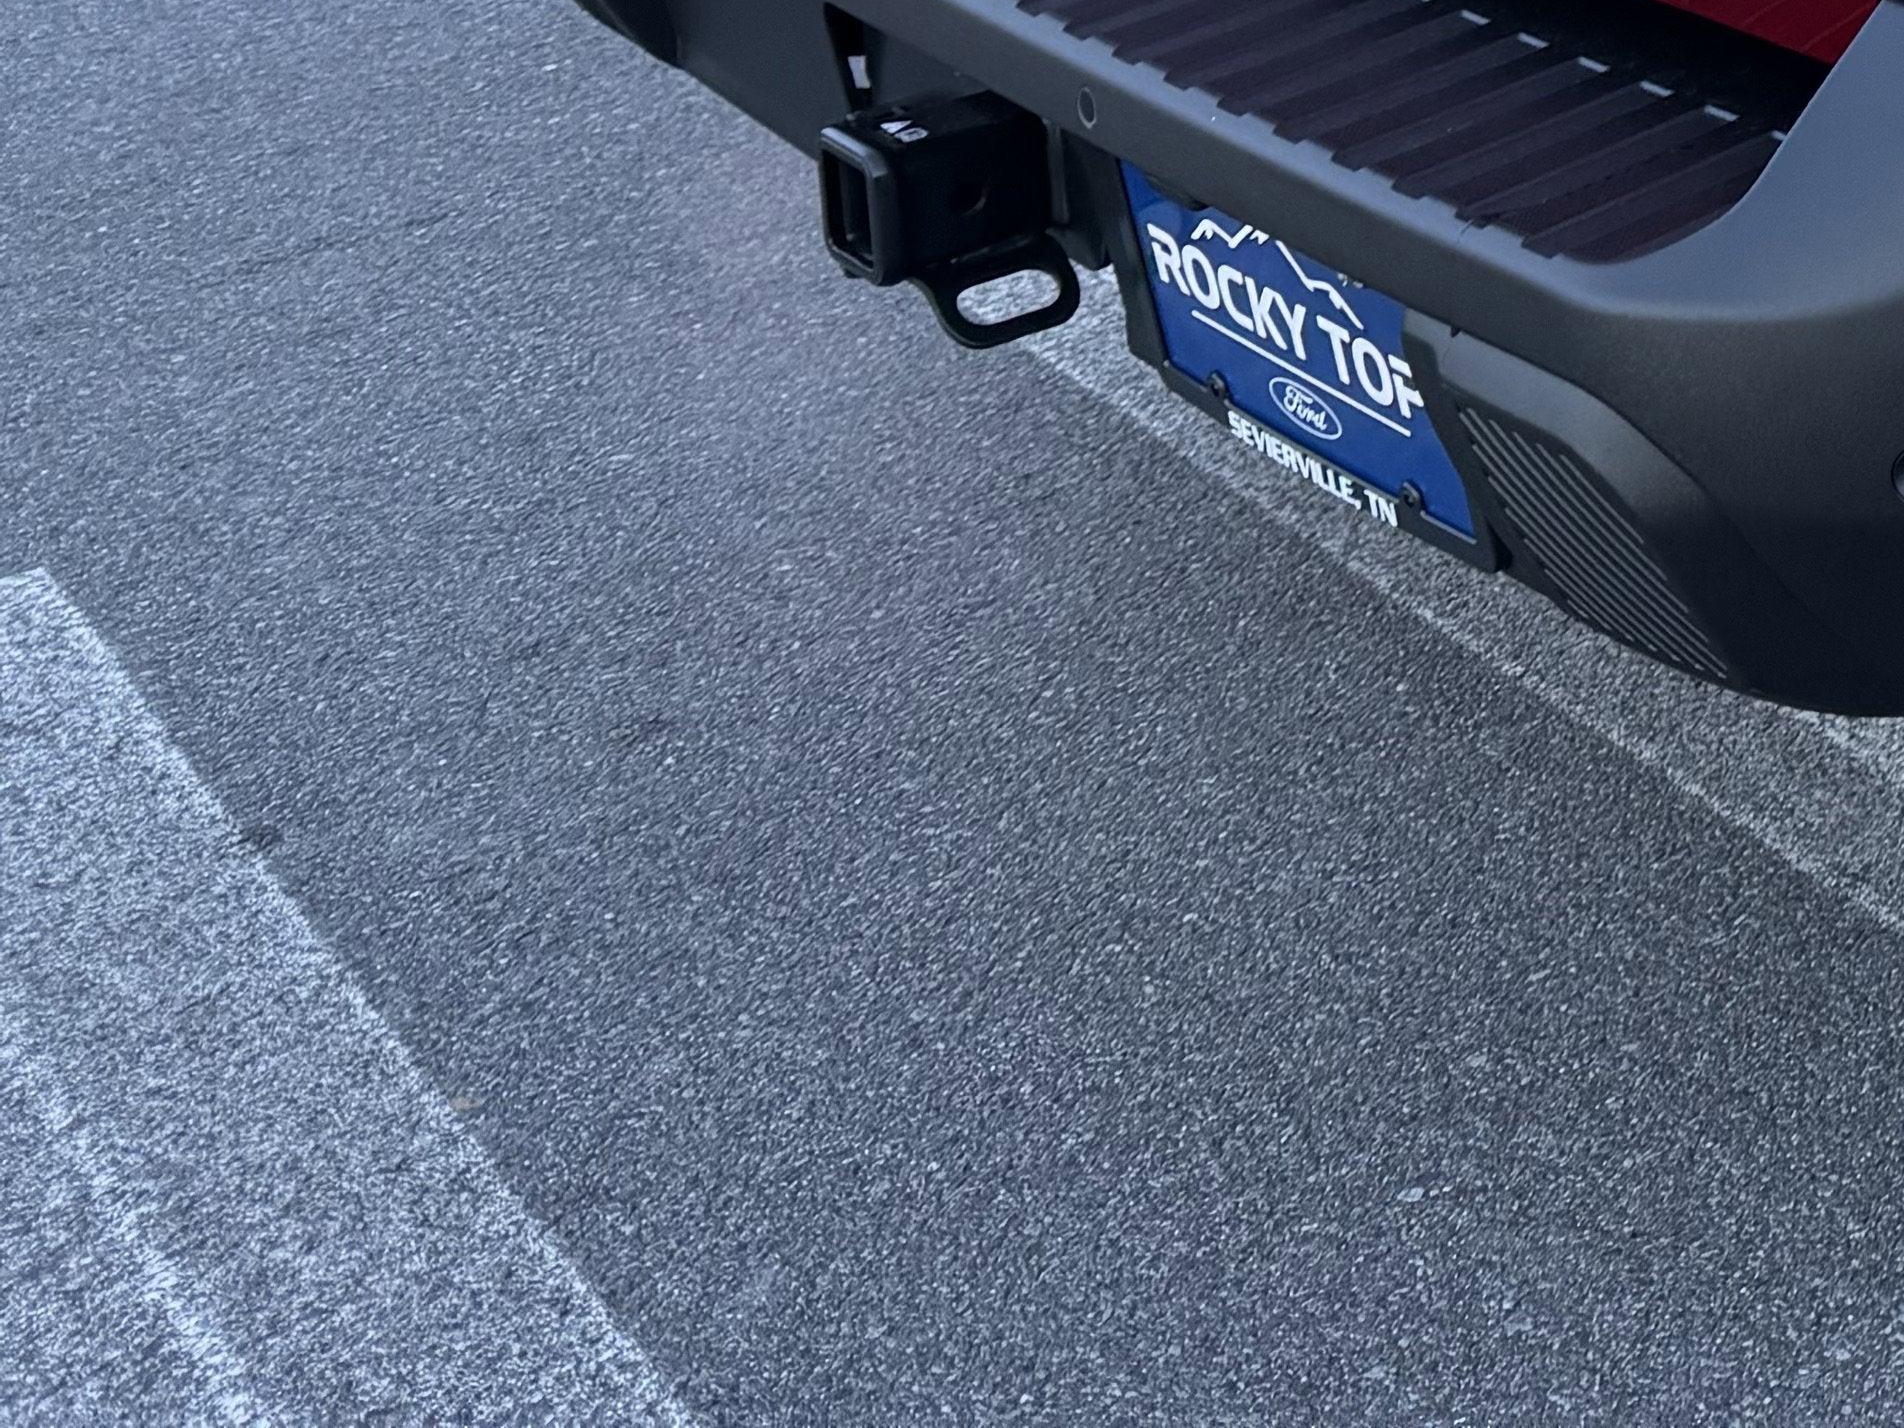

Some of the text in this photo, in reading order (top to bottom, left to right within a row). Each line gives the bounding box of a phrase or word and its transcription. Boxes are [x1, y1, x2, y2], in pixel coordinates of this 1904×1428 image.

[1147, 223, 1424, 419] ROCKY TOP
[1283, 385, 1328, 431] Ford
[1227, 409, 1399, 528] SEVIERVILLE, TN
